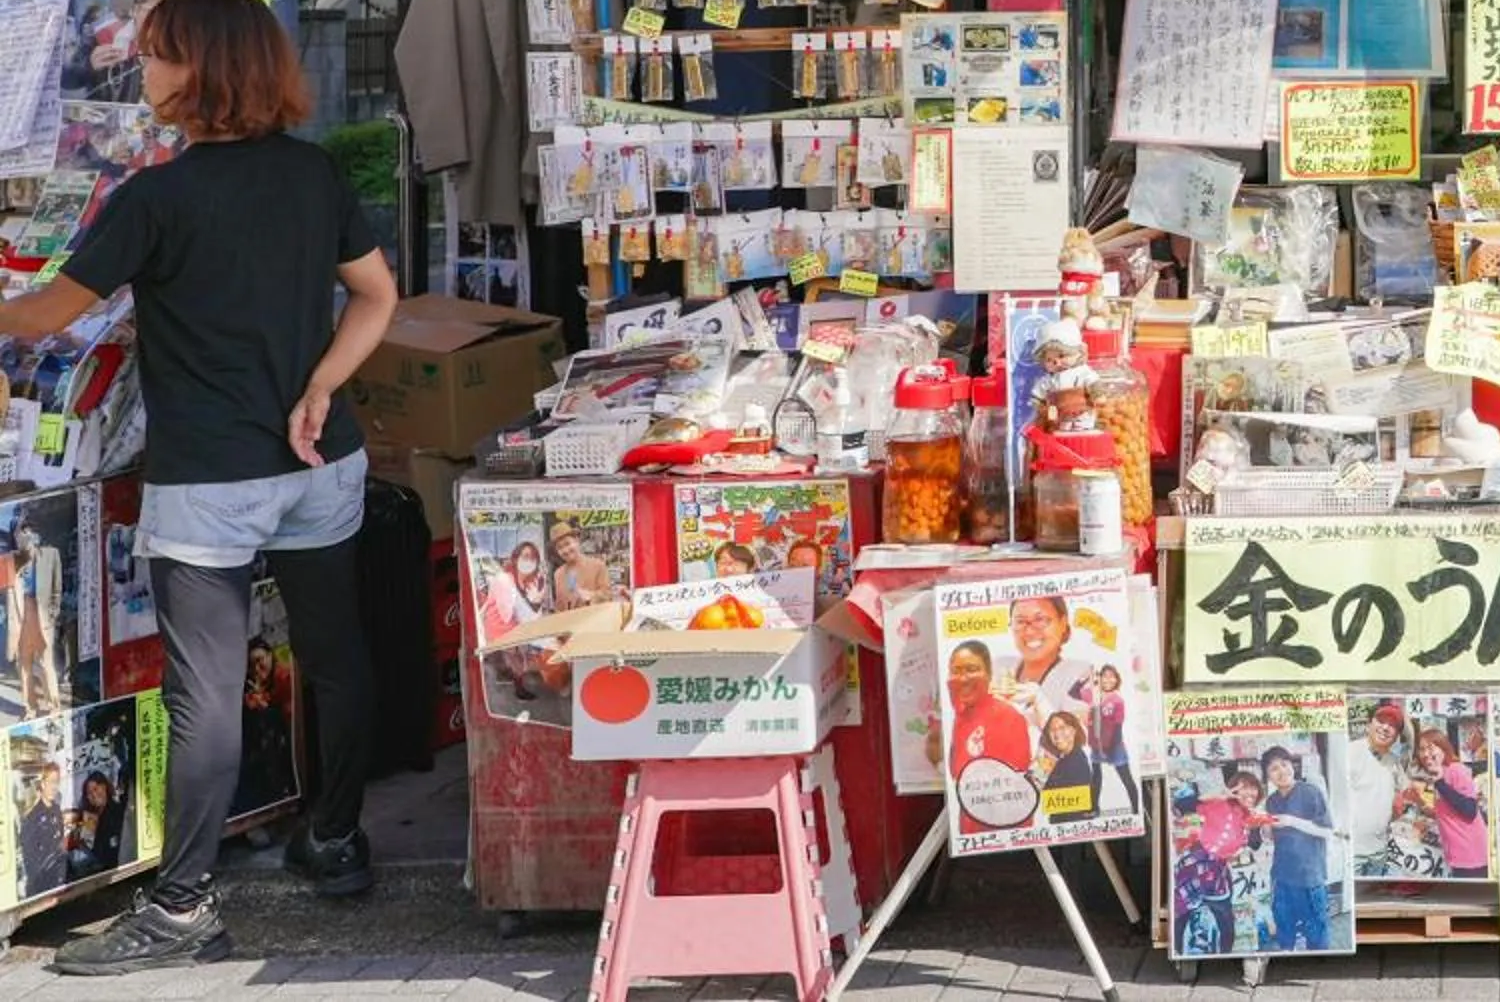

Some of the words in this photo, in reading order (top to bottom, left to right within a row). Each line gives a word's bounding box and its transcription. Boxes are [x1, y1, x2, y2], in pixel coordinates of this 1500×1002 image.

[947, 616, 999, 634] Before
[656, 675, 798, 705] 愛媛みかん
[656, 717, 726, 736] 産地直送
[1046, 794, 1081, 810] After
